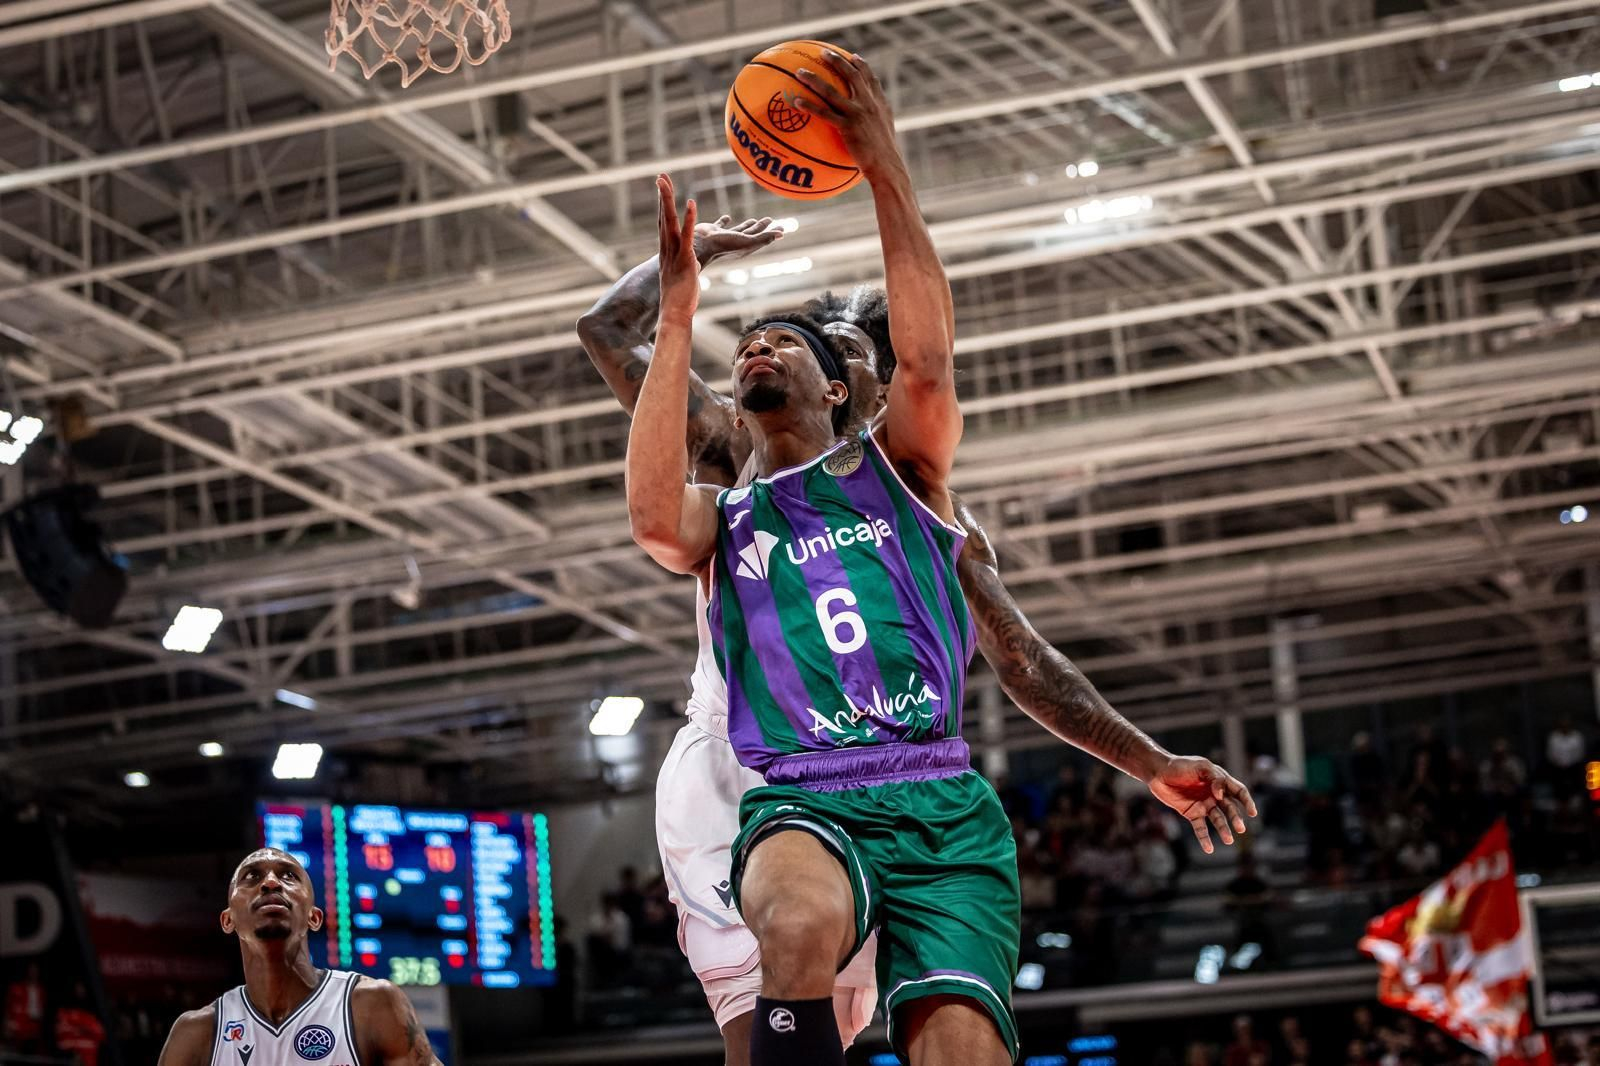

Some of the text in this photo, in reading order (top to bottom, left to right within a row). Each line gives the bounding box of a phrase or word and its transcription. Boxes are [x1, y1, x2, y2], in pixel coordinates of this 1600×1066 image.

[730, 112, 814, 188] Wilson
[786, 515, 894, 565] Unicaja
[815, 588, 867, 654] 6
[807, 672, 942, 741] Andalucía
